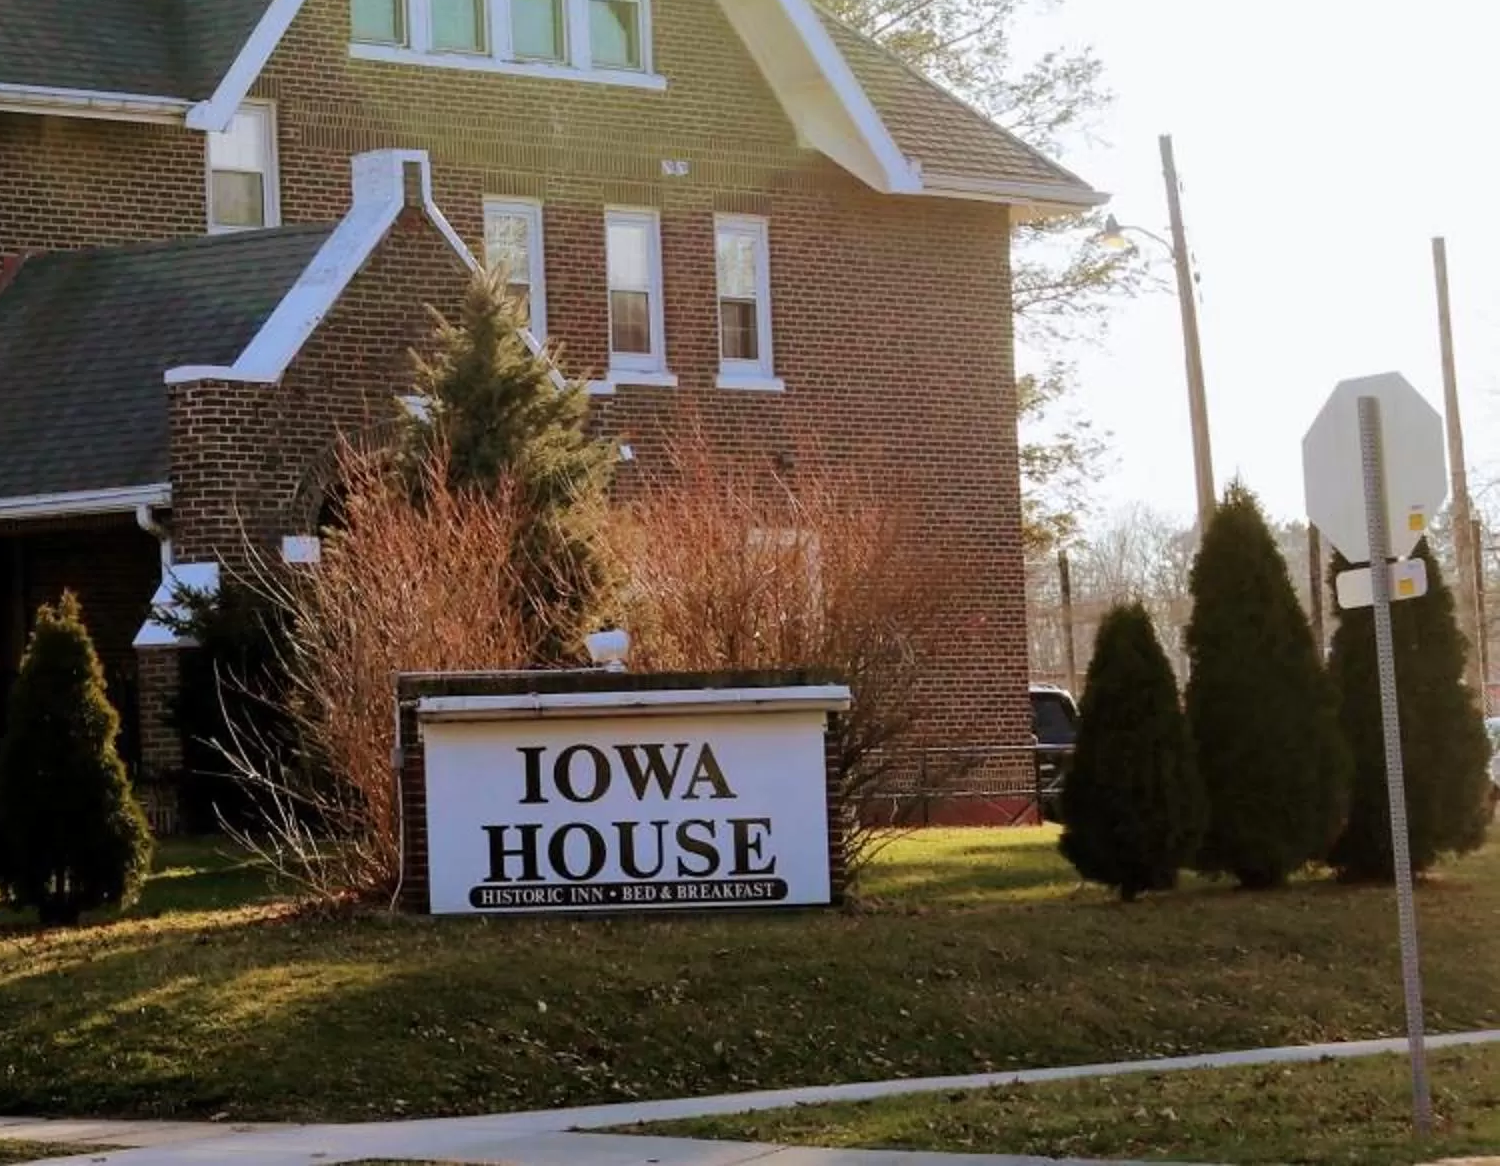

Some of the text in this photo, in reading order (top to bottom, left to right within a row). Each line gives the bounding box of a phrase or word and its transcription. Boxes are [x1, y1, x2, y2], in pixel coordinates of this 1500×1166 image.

[516, 742, 737, 804] IOWA
[481, 817, 776, 882] HOUSE
[481, 882, 775, 905] HISTORIC INN BED & BREAKFAST
